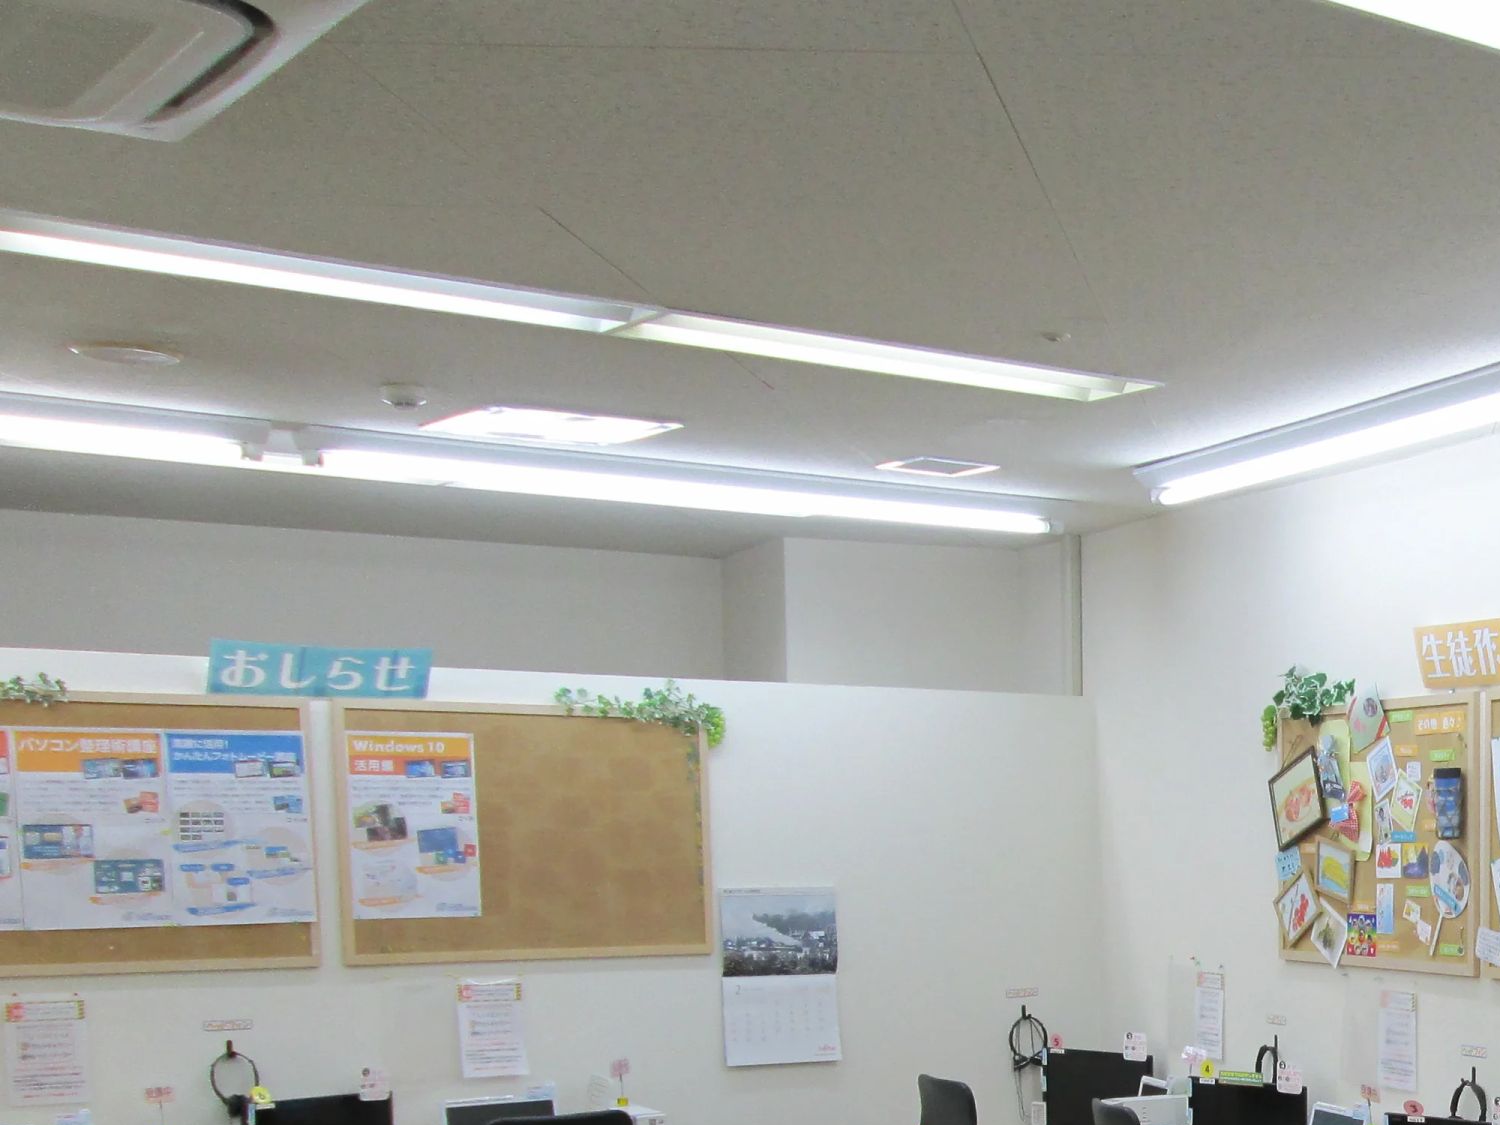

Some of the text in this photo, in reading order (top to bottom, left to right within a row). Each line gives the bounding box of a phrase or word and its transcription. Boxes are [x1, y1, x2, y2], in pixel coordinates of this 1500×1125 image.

[220, 649, 416, 692] おしらせ
[352, 739, 445, 753] Windows 10
